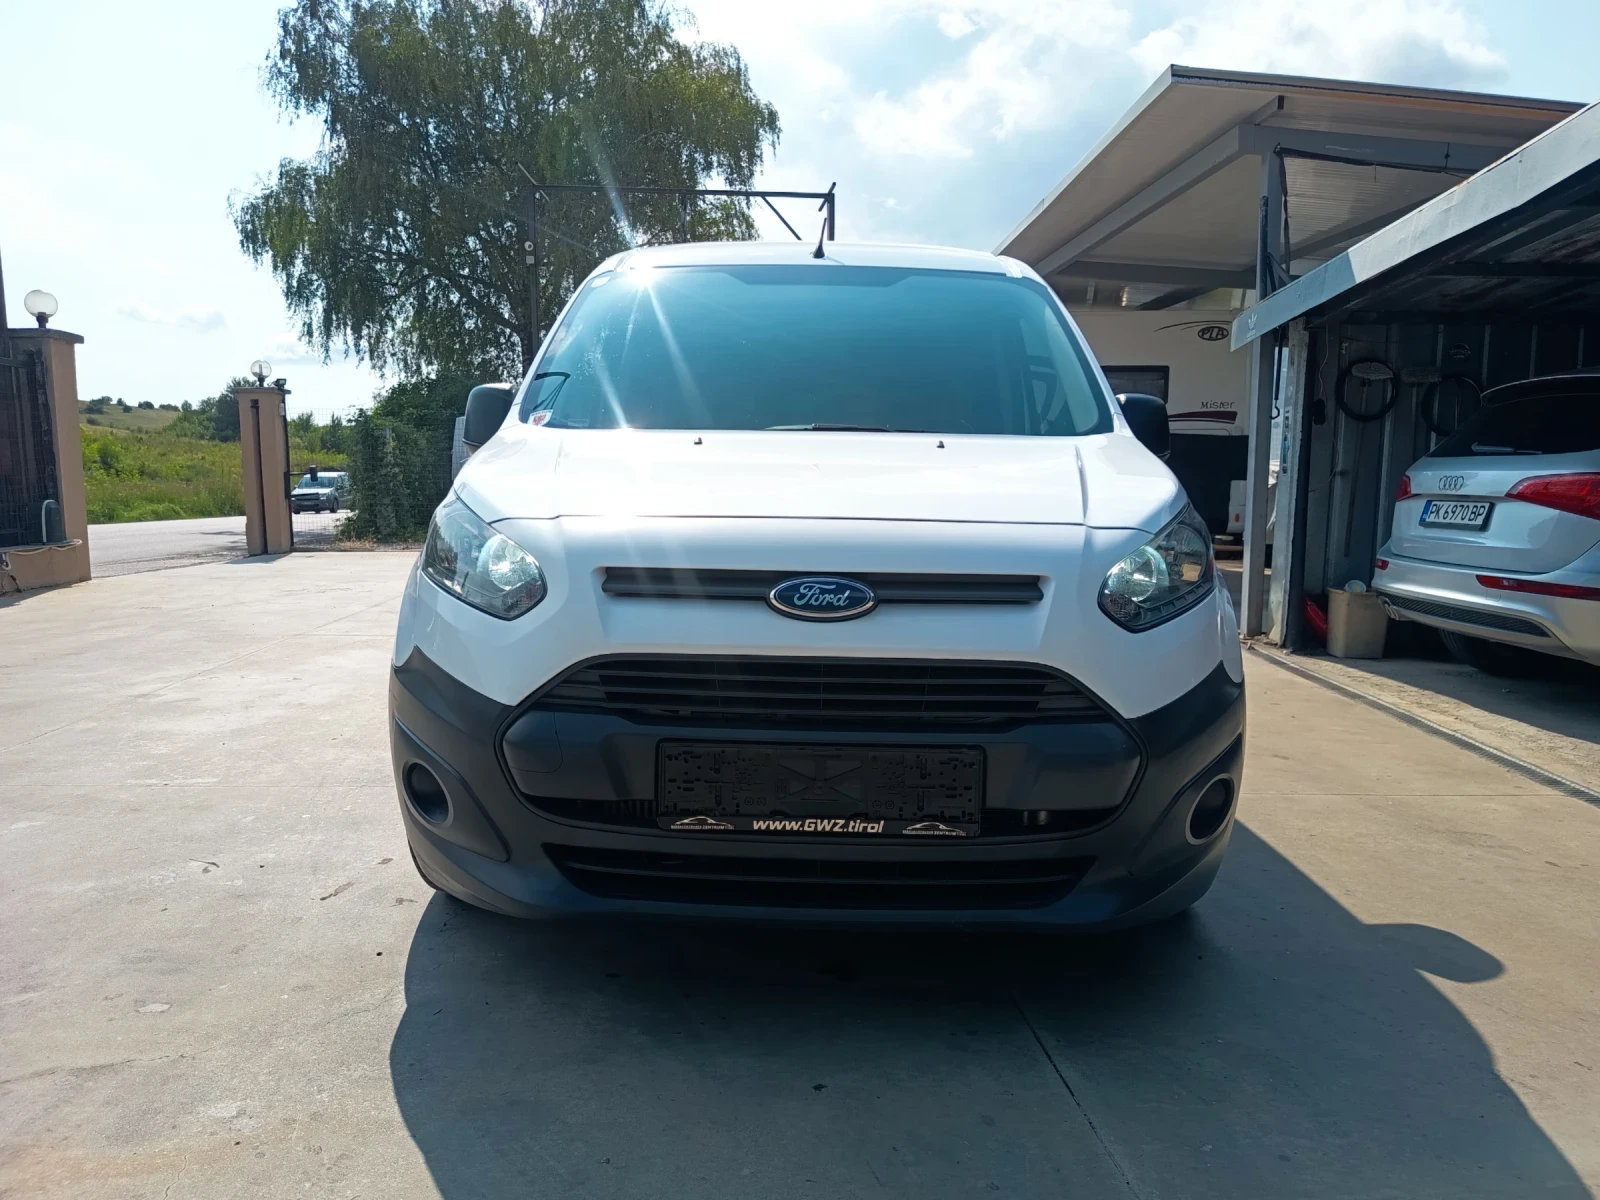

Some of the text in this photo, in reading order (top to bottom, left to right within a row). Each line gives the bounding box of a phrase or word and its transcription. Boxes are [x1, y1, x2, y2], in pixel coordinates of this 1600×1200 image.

[1201, 328, 1225, 339] PLA
[1200, 400, 1235, 409] Mister
[1428, 503, 1486, 521] PK 6970 BP
[794, 583, 850, 606] Ford
[752, 819, 884, 833] www.GWZ.tirol
